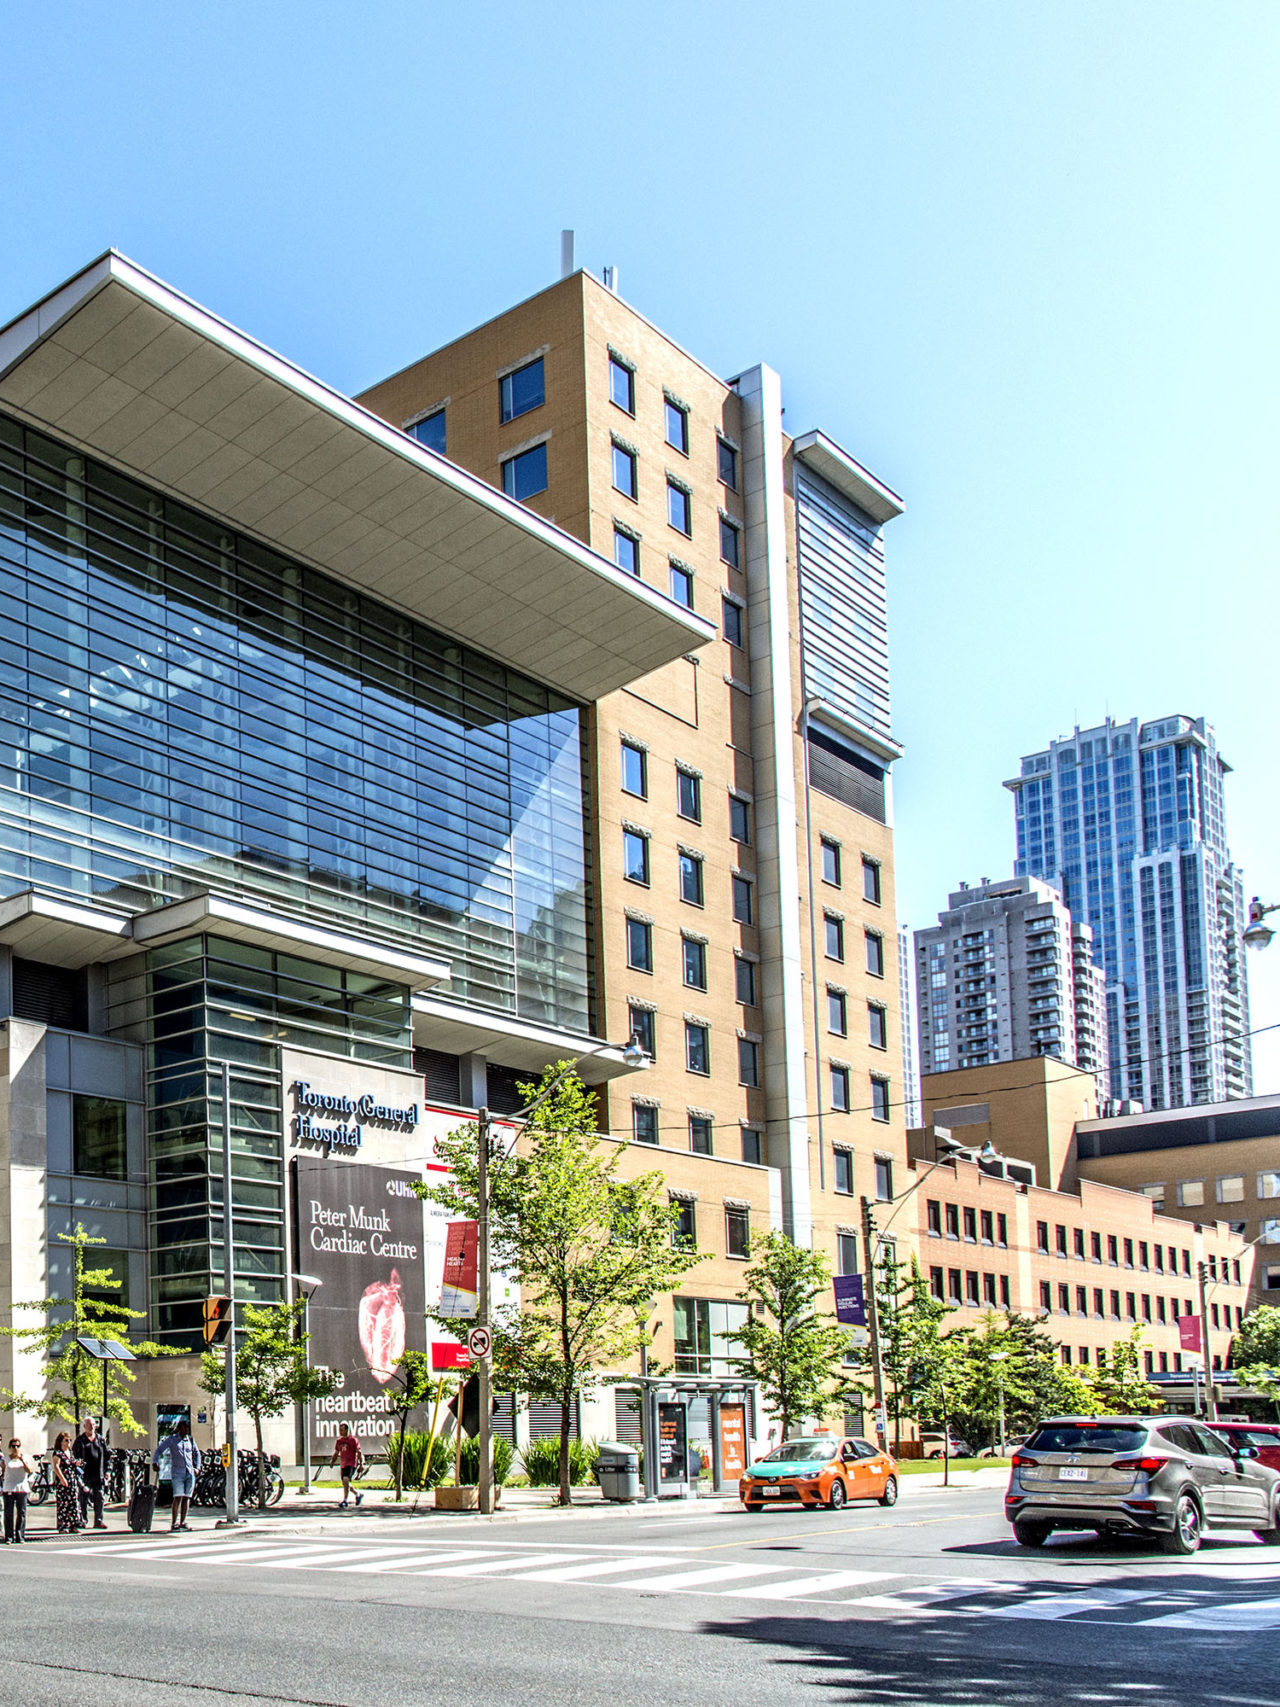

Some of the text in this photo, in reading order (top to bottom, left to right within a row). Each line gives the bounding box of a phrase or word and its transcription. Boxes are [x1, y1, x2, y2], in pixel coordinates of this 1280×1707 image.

[295, 1080, 419, 1125] Toronto General
[297, 1114, 362, 1151] Hospital
[310, 1200, 391, 1232] Peter Munk
[311, 1227, 418, 1259] Cardiac Centre
[315, 1390, 391, 1413] heartbeat
